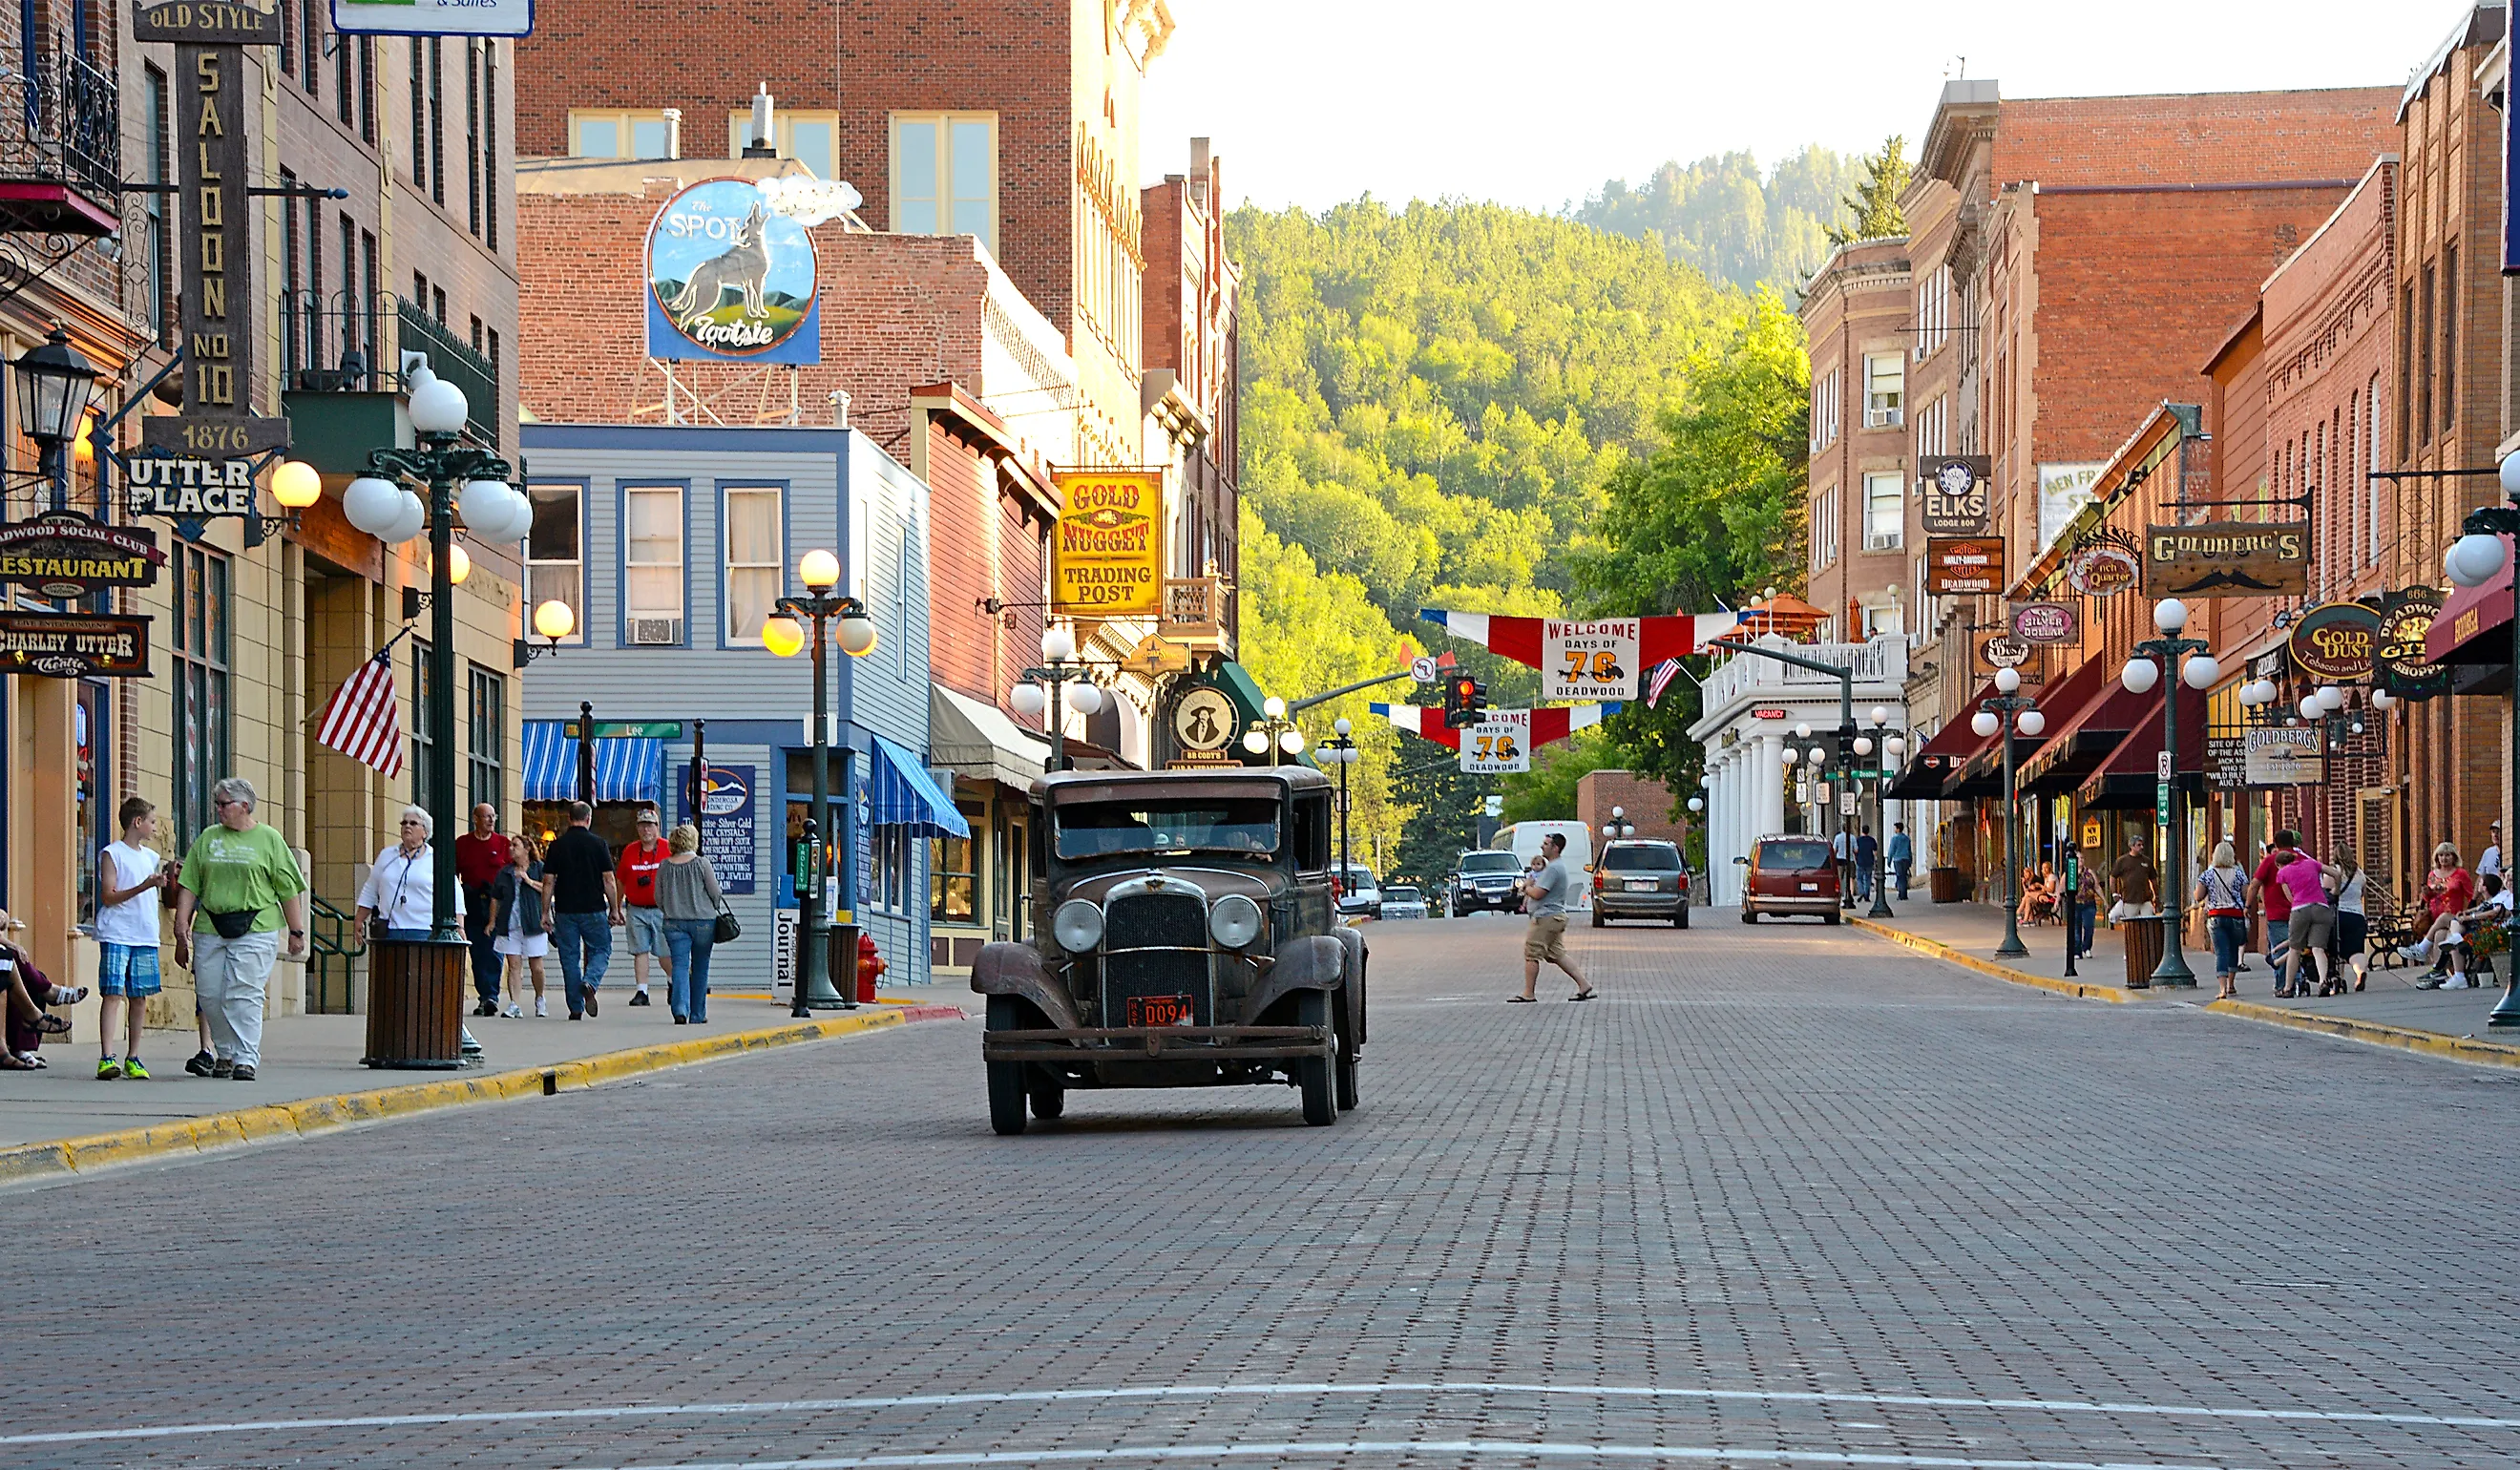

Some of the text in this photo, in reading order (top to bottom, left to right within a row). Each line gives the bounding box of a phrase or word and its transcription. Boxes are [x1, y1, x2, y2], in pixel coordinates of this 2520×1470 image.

[150, 4, 263, 31] OLD STYLE
[198, 52, 226, 319] SALOON
[669, 214, 745, 240] SPOT
[694, 316, 774, 351] Tootsie
[194, 333, 229, 358] NO
[198, 365, 234, 405] 10
[182, 425, 249, 450] 1876
[129, 458, 251, 488] UTTER
[2046, 473, 2074, 495] BEN
[129, 487, 250, 514] PLACE
[1073, 484, 1140, 510] GOLD
[1927, 496, 1984, 516] ELKS
[60, 525, 109, 541] SOCIAL
[113, 534, 148, 556] CLUB
[1062, 521, 1149, 552] NUGGET
[2153, 531, 2300, 561] GOLDBERG'S
[0, 556, 146, 579] ESTAURANT
[1064, 567, 1151, 584] TRADING
[1942, 578, 1990, 589] DEADWOOD
[2090, 573, 2131, 587] Quarter
[1079, 585, 1134, 603] POST
[2407, 588, 2427, 599] 666
[1548, 622, 1636, 641] WELCOME
[2024, 626, 2065, 637] DOLLAR
[2025, 616, 2064, 627] SILVER
[76, 633, 134, 658] UTTER
[1565, 640, 1618, 649] DAYS OF
[2312, 627, 2369, 646] GOLD
[2303, 650, 2339, 673] Tobacco
[2342, 662, 2358, 673] and
[2323, 644, 2374, 659] DUST
[1565, 651, 1617, 683] 76
[1557, 686, 1625, 696] DEADWOOD
[1755, 709, 1784, 719] VACANCY
[626, 724, 643, 736] Lee
[1477, 736, 1515, 762] 76
[1469, 763, 1520, 771] DEADWOOD
[716, 829, 746, 837] CRYSTALS
[738, 817, 752, 830] Gold
[776, 912, 793, 988] Journal
